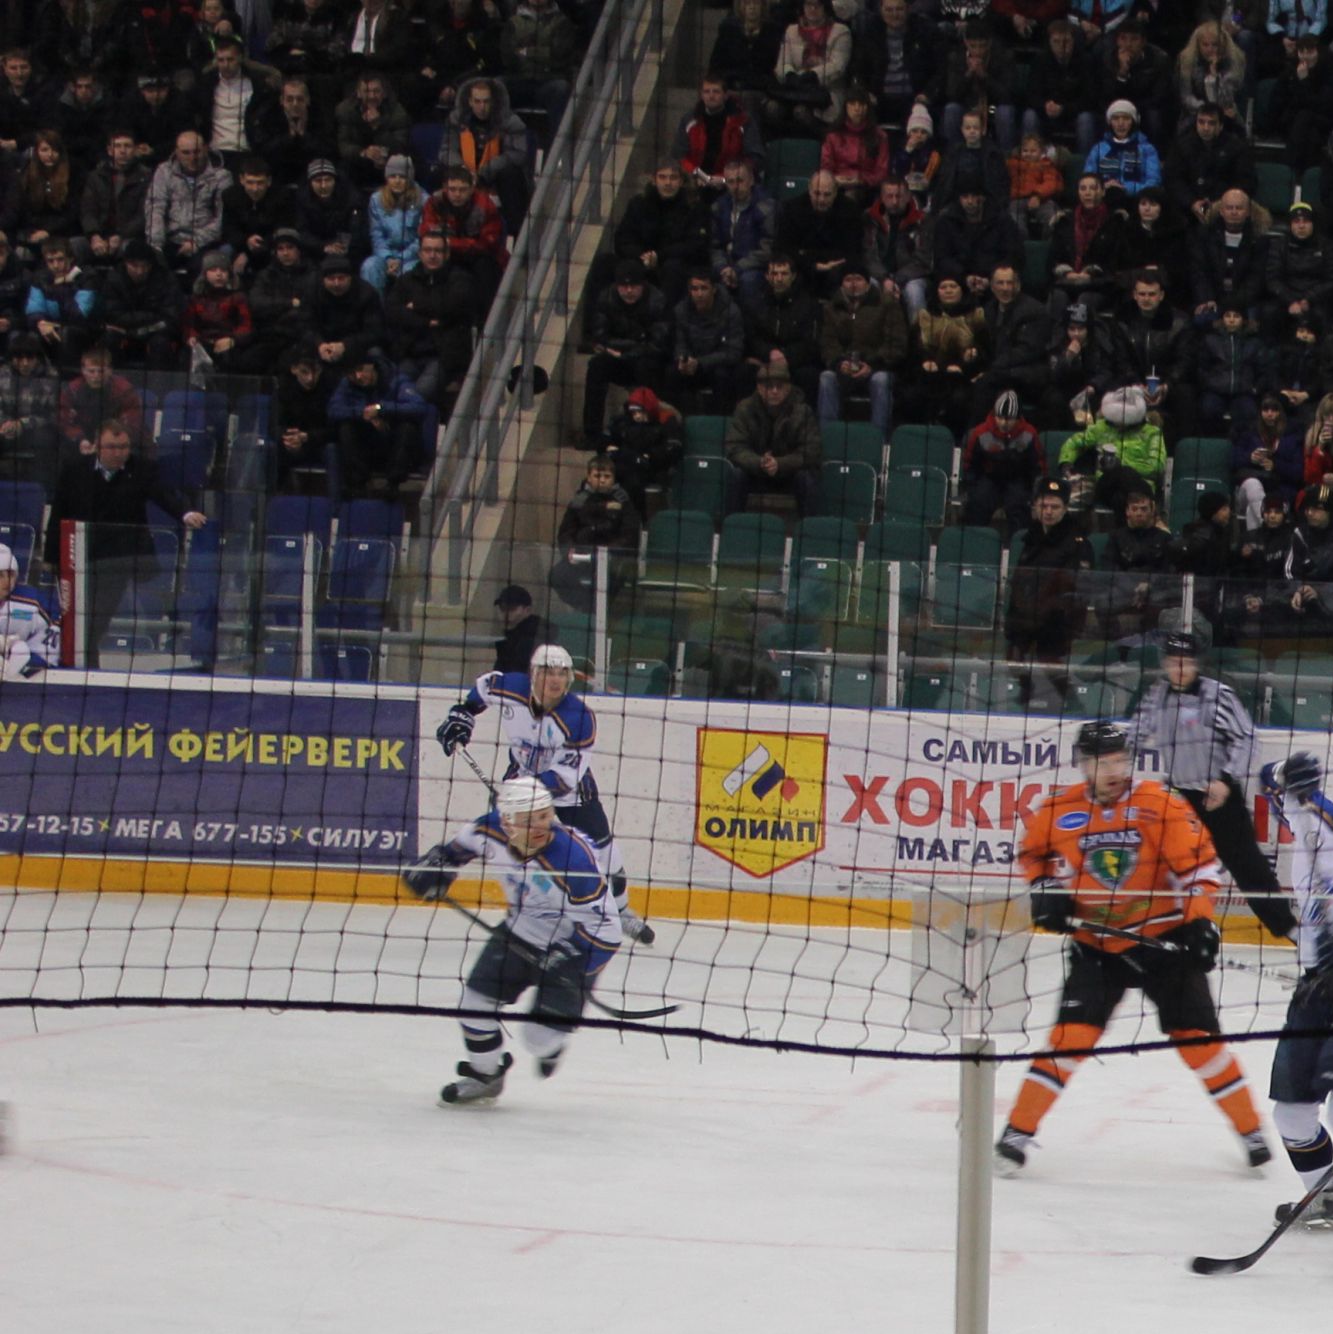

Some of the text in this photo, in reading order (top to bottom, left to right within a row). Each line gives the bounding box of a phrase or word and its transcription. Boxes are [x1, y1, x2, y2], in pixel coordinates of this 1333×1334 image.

[168, 727, 406, 771] ФЕЙЕРВЕРК
[923, 737, 1058, 767] САМЫЙ
[842, 774, 1062, 831] ХОКК
[114, 818, 183, 840] МЕГА
[193, 822, 287, 845] 677-155
[307, 826, 409, 849] СИЛУЭТ
[704, 816, 817, 843] ОЛИМП
[899, 836, 1016, 866] МАГАЗ
